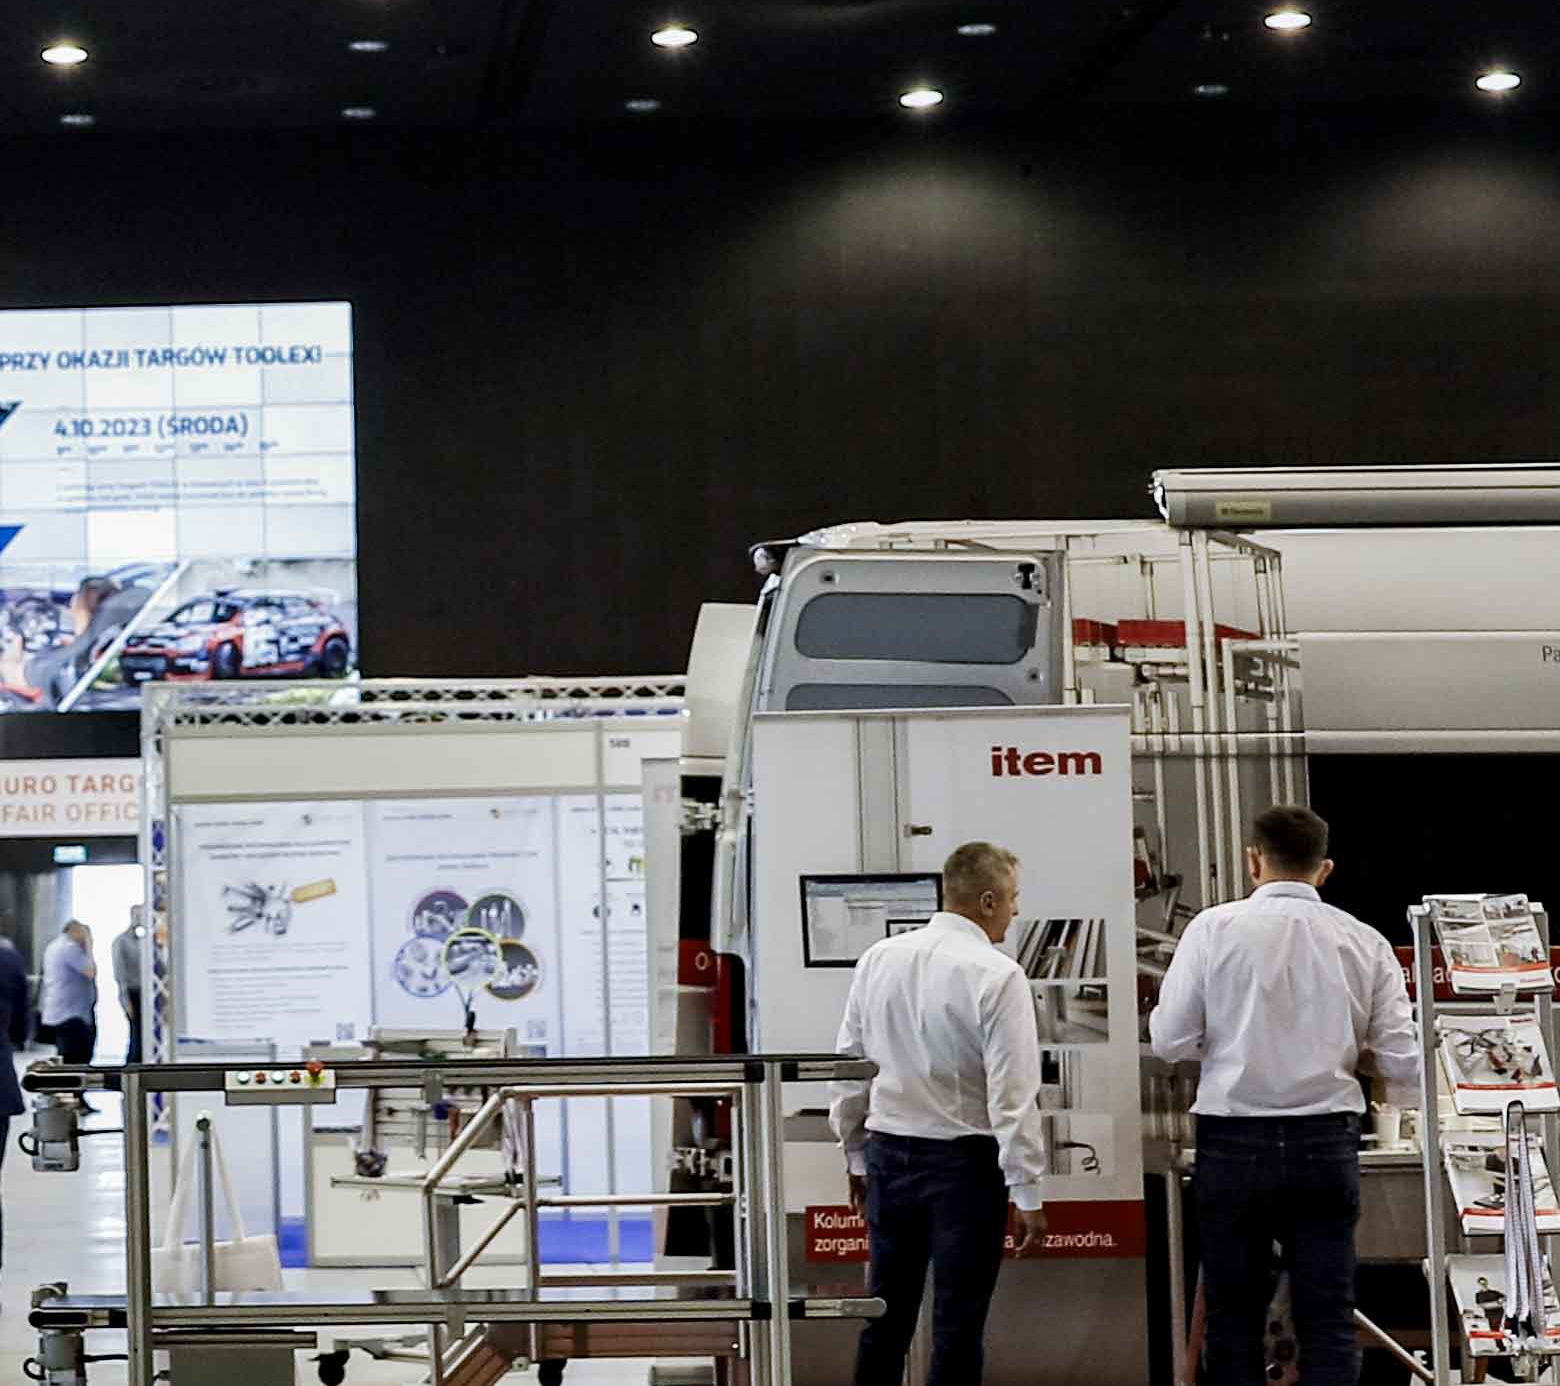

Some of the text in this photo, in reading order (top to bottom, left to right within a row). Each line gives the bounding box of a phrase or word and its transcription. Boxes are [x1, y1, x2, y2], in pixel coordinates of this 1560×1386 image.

[56, 350, 129, 370] OKAZJI
[135, 345, 226, 368] TARGÓW
[158, 413, 249, 438] (ŚRODA)
[990, 745, 1104, 777] item
[68, 774, 144, 794] TARG
[1, 801, 139, 824] FAIR OFFIC
[814, 1232, 871, 1256] zorgani
